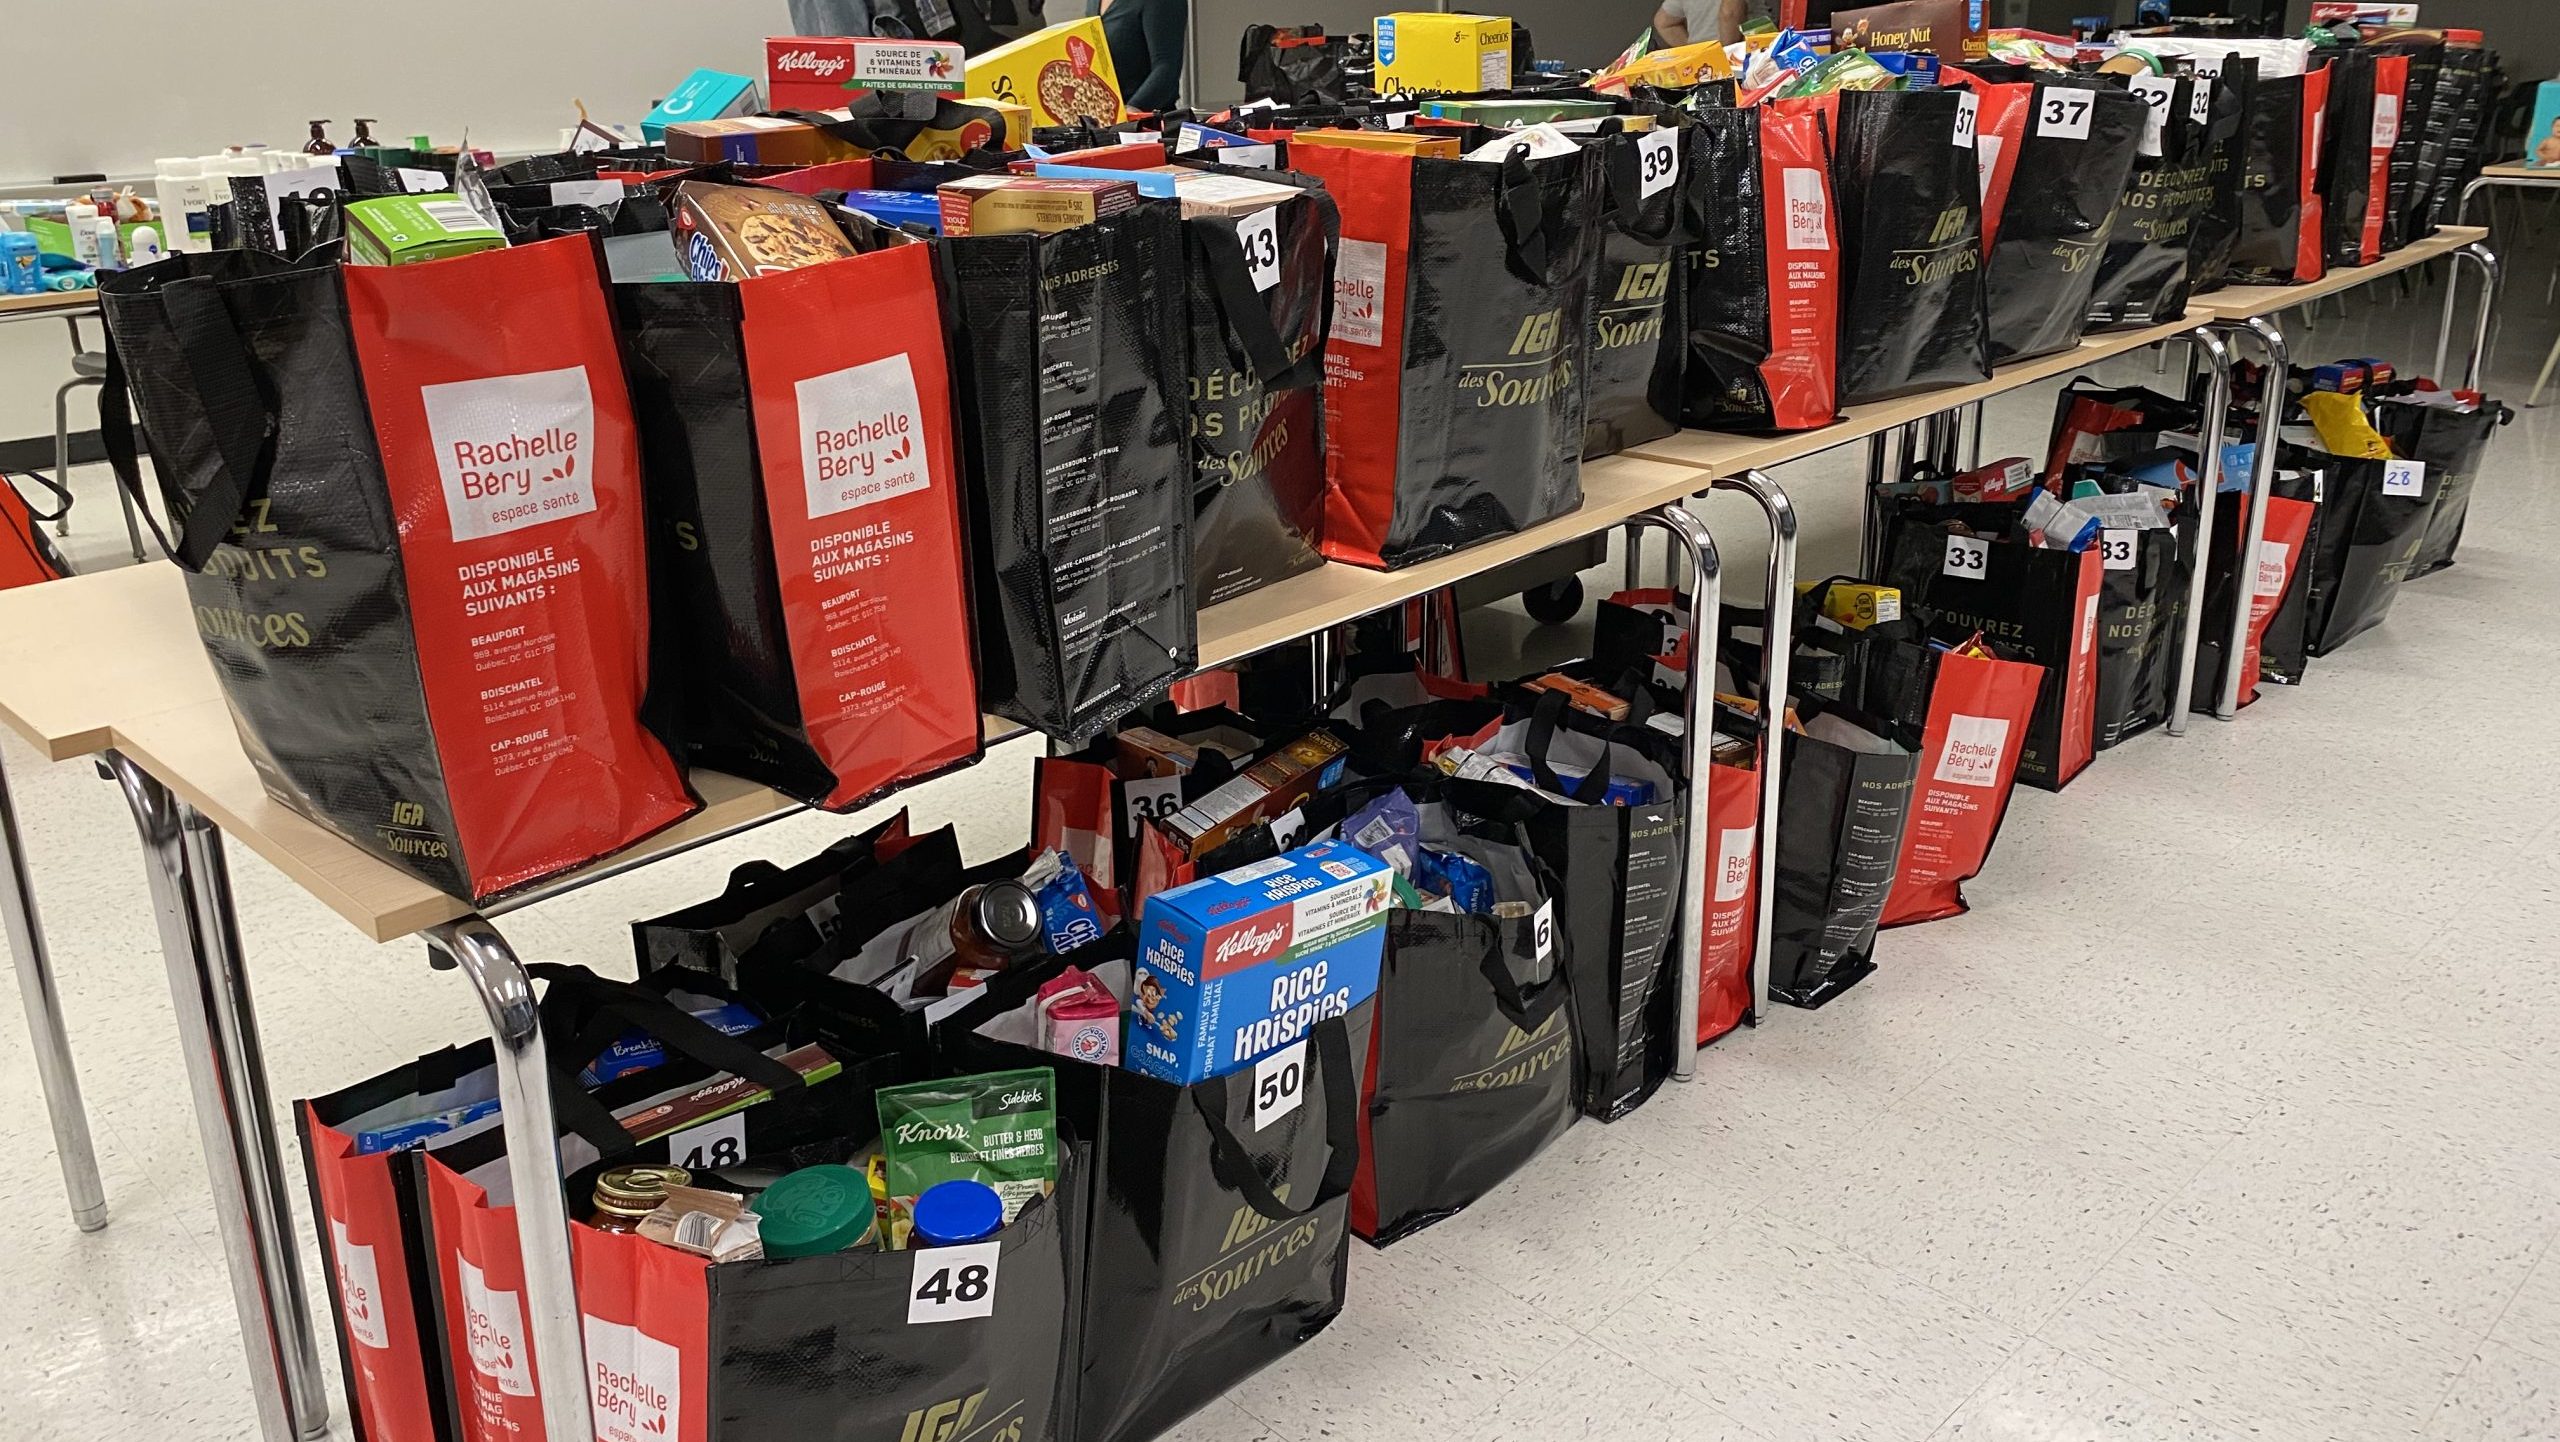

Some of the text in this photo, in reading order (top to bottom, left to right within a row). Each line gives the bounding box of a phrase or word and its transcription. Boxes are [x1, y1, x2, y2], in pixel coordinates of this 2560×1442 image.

[1480, 32, 1508, 46] Cheerios
[1871, 28, 1931, 48] Honey Nut
[778, 50, 847, 76] Kellogg's
[870, 58, 921, 67] 8 VITAMINES
[876, 50, 907, 58] SOURCE
[898, 82, 924, 90] GRAINS
[924, 82, 953, 90] ENTIERS
[2044, 100, 2090, 126] 37
[2194, 92, 2208, 115] 32
[1956, 108, 1973, 134] 37
[1644, 145, 1673, 184] 39
[1929, 206, 1968, 243] IGA
[2134, 218, 2150, 228] des
[690, 232, 722, 280] Chips
[1245, 228, 1276, 273] 43
[2053, 244, 2072, 258] des
[1064, 260, 1120, 286] ADRESSES
[1890, 250, 1978, 285] des Sources
[1614, 261, 1672, 300] IGA
[1508, 308, 1562, 355] IGA
[1458, 360, 1572, 407] des Sources
[816, 412, 908, 454] Rachelle
[454, 428, 578, 469] Rachelle
[1198, 457, 1226, 470] des
[1221, 418, 1288, 487] Sources
[818, 450, 874, 482] Béry
[461, 468, 530, 500] Béry
[842, 471, 915, 501] espace santé
[2387, 472, 2410, 486] 28
[492, 491, 580, 523] espace santé
[810, 521, 891, 552] DISPONIBLE
[812, 531, 914, 568] AUX MAGASINS
[1949, 547, 1984, 570] 33
[2103, 541, 2130, 562] 33
[458, 546, 555, 581] DISPONIBLE
[814, 554, 882, 582] SUIVANTS
[463, 558, 580, 600] AUX MAGASINS
[465, 585, 546, 617] SUIVANTS
[822, 589, 860, 610] BEAUPORT
[471, 626, 526, 647] BEAUPORT
[2109, 624, 2142, 638] NOS
[494, 644, 522, 655] avenue
[510, 654, 521, 663] QC
[524, 648, 542, 659] G1C
[831, 634, 878, 658] BOISCHATEL
[480, 676, 544, 700] BOISCHATEL
[838, 680, 886, 703] CAP-ROUGE
[483, 694, 536, 713] 5114, avenue
[530, 702, 542, 712] QC
[862, 700, 873, 708] rue
[490, 728, 550, 752] CAP-ROUGE
[1952, 740, 1998, 758] Rachelle
[493, 744, 542, 765] 3373, rue de
[528, 756, 540, 766] QC
[1947, 753, 1976, 771] Béry
[1862, 781, 1882, 790] NOS
[1928, 790, 1970, 802] DISPONIBLE
[393, 802, 425, 826] IGA
[1132, 792, 1178, 820] 36
[1924, 804, 1959, 816] SUIVANTS
[1925, 797, 1978, 811] AUX MAGASINS
[387, 830, 448, 858] Sources
[1631, 829, 1649, 839] NOS
[1305, 894, 1362, 917] VITAMINS MINERALS
[1330, 890, 1351, 902] SOURCE
[1329, 908, 1350, 920] SOURCE
[1215, 922, 1284, 963] Kellogg's
[1298, 923, 1326, 938] VITAMINES
[1198, 983, 1214, 1048] FAMILY SIZE
[1204, 979, 1224, 1079] FORMAT FAMILIAL
[1146, 1042, 1180, 1068] SNAP,
[689, 1076, 746, 1102] Kellogg's
[1258, 1062, 1300, 1110] 50
[1451, 1079, 1476, 1093] des
[999, 1088, 1043, 1111] Sidekicks
[896, 1121, 967, 1145] Knorr
[983, 1128, 1043, 1148] BUTTER & HERB
[674, 1137, 739, 1170] 48
[950, 1150, 980, 1164] BEURRE
[980, 1149, 990, 1162] ET
[1173, 1218, 1320, 1312] des Sources
[916, 1265, 988, 1305] 48
[597, 1362, 667, 1411] Rachelle
[598, 1384, 636, 1428] Béry
